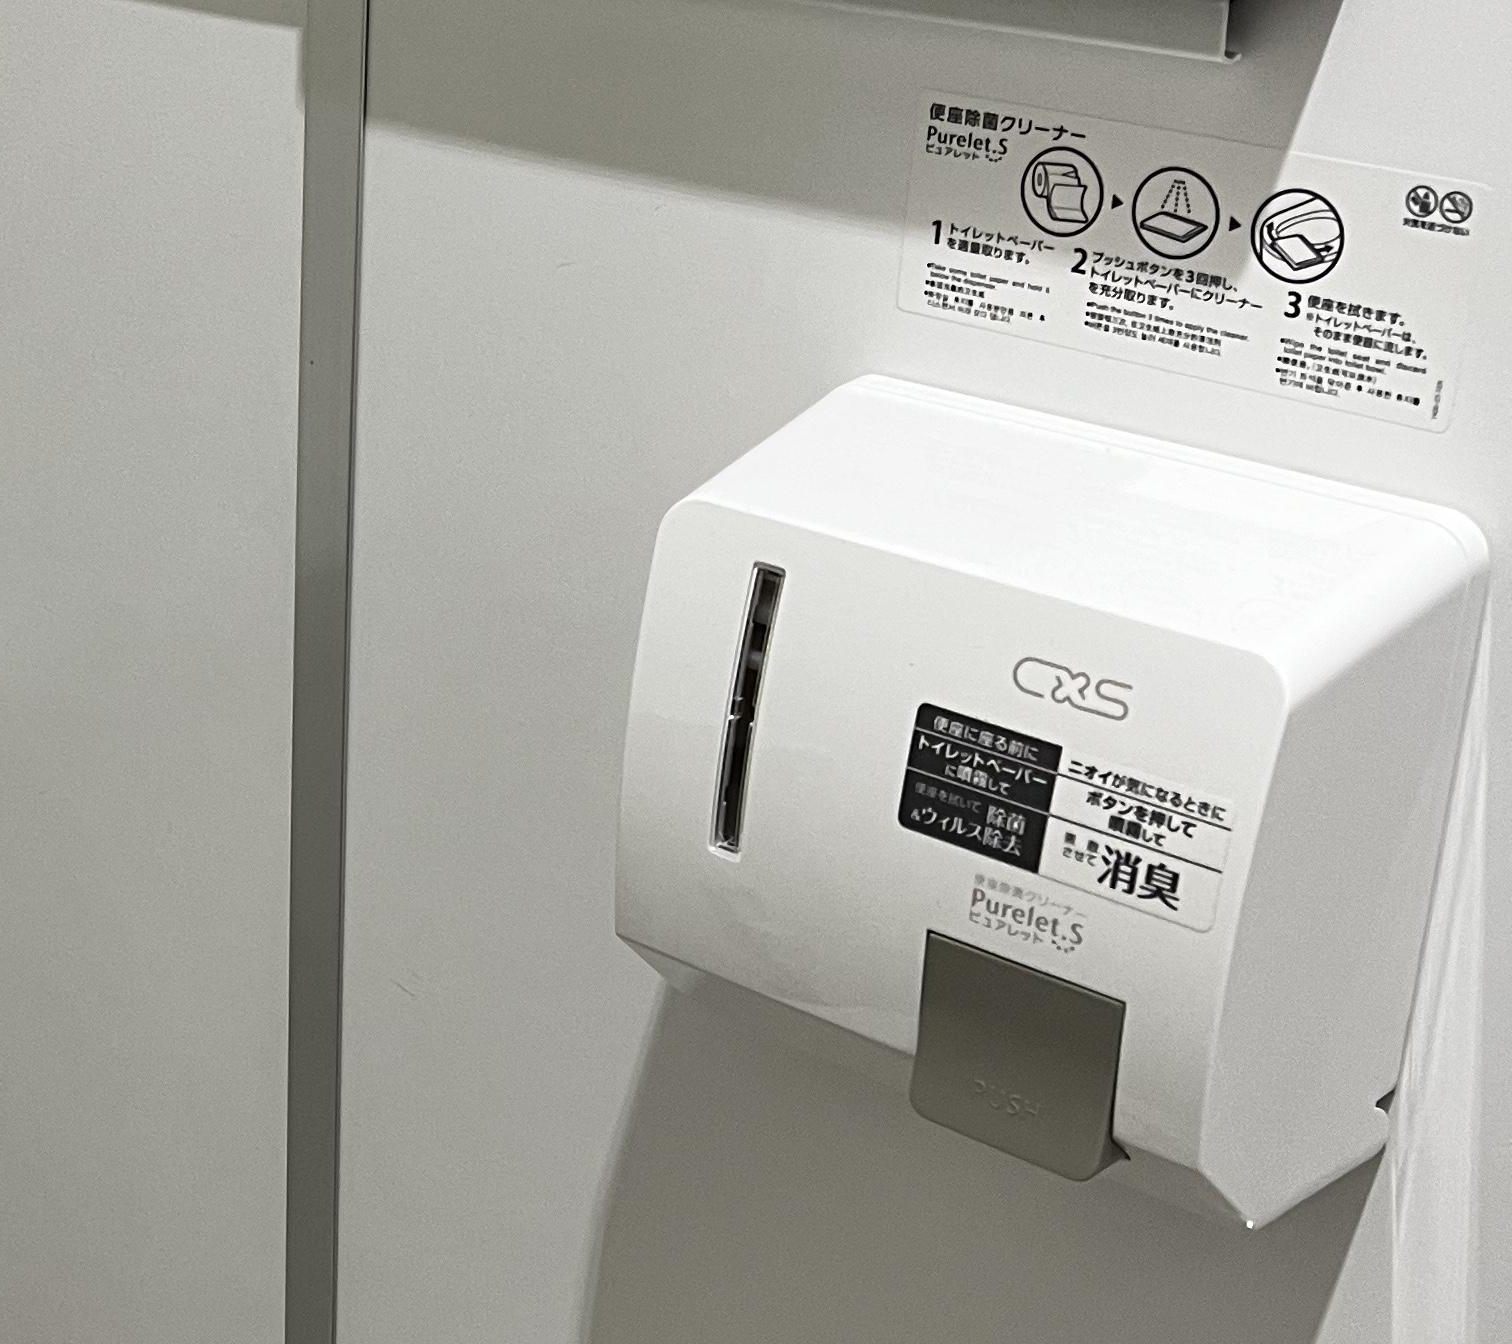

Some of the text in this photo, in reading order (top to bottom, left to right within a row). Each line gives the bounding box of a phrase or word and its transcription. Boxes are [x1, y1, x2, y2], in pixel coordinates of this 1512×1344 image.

[932, 219, 942, 245] 1
[950, 223, 1055, 251] トイレットペーパー
[1071, 247, 1088, 275] 2
[1090, 266, 1263, 309] トイレットペーパーにクリーナー
[1284, 291, 1302, 318] 3
[918, 735, 1048, 785] トイレットペーパー
[1068, 760, 1227, 822] ニオイが気になるときに
[1086, 790, 1197, 839] ボタンを押して
[1097, 844, 1180, 912] 消臭
